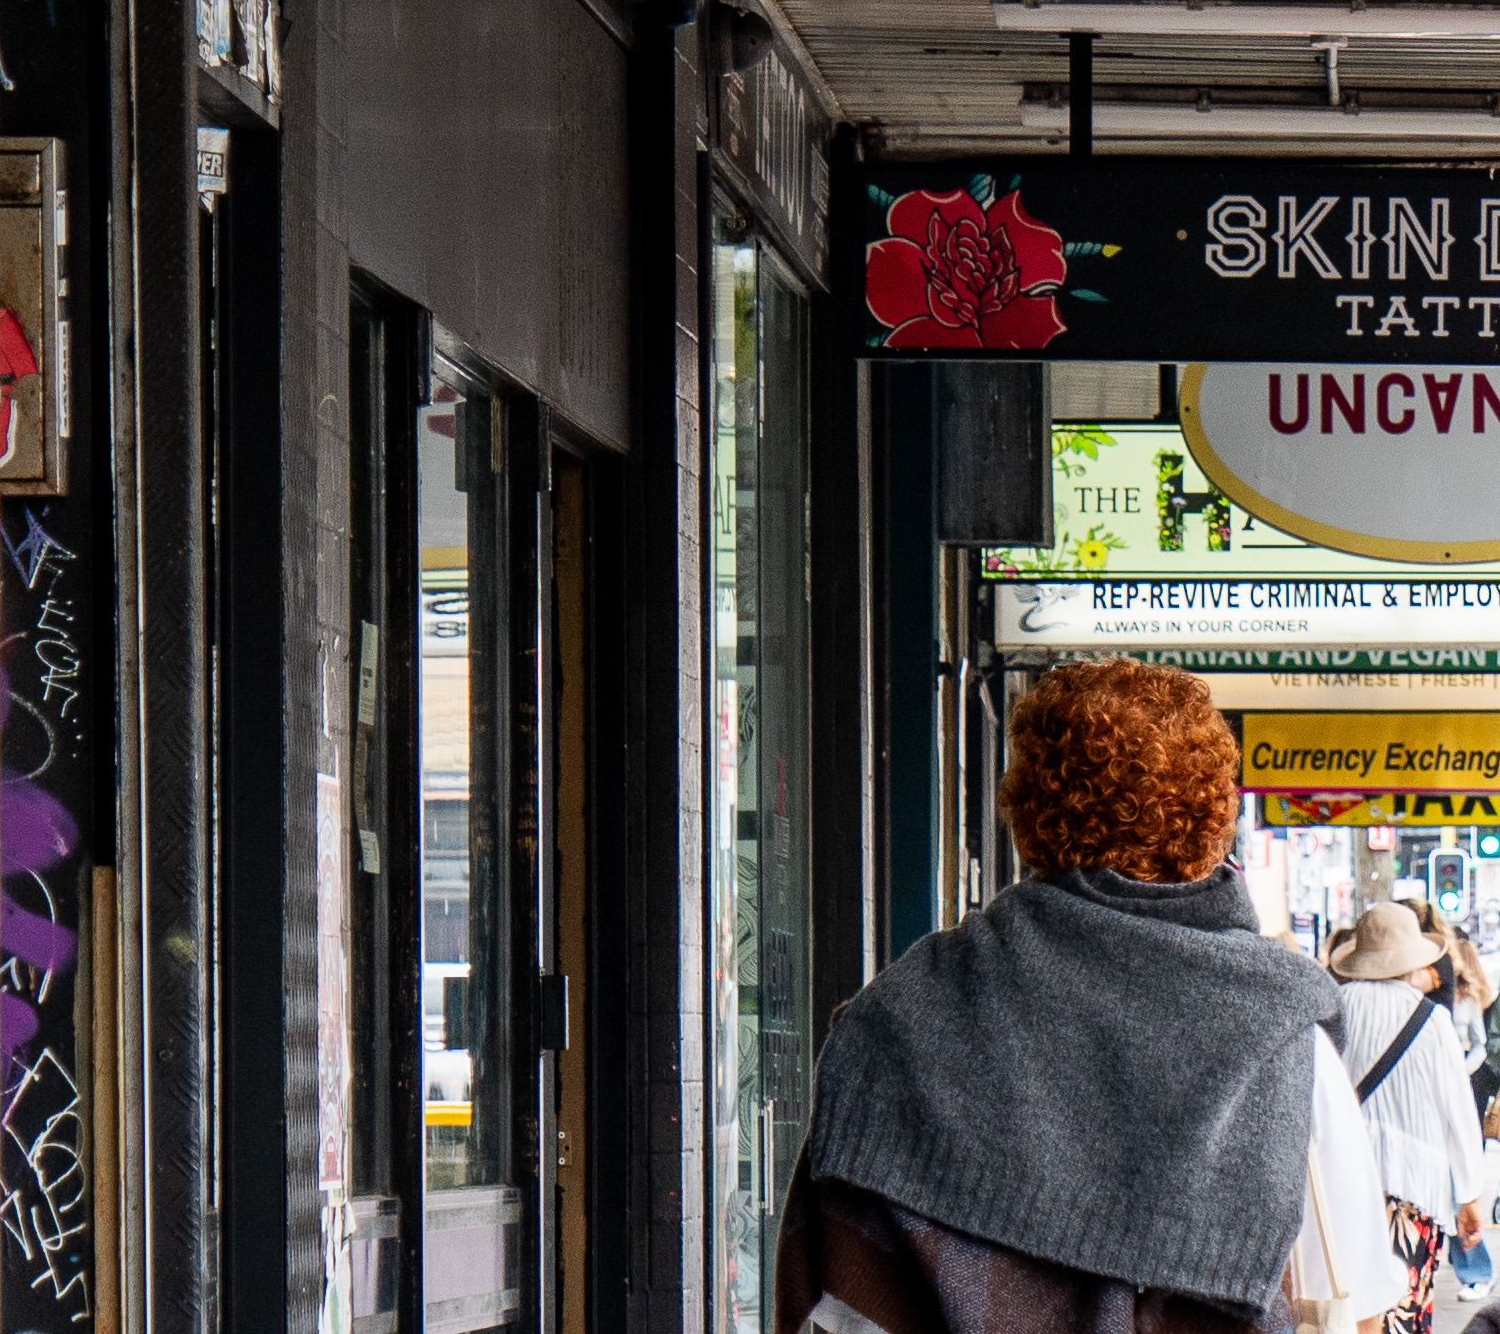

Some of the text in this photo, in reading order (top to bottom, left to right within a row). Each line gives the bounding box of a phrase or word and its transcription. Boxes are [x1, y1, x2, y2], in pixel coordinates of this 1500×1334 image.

[1205, 194, 1454, 283] SKIN
[1074, 487, 1142, 514] THE
[1093, 583, 1242, 610] REP-REVIVE
[1250, 584, 1372, 609] CRIMINAL
[1382, 583, 1397, 608] &
[1094, 619, 1310, 633] ALWAYS IN YOUR CORNER
[1252, 741, 1376, 777] Currency
